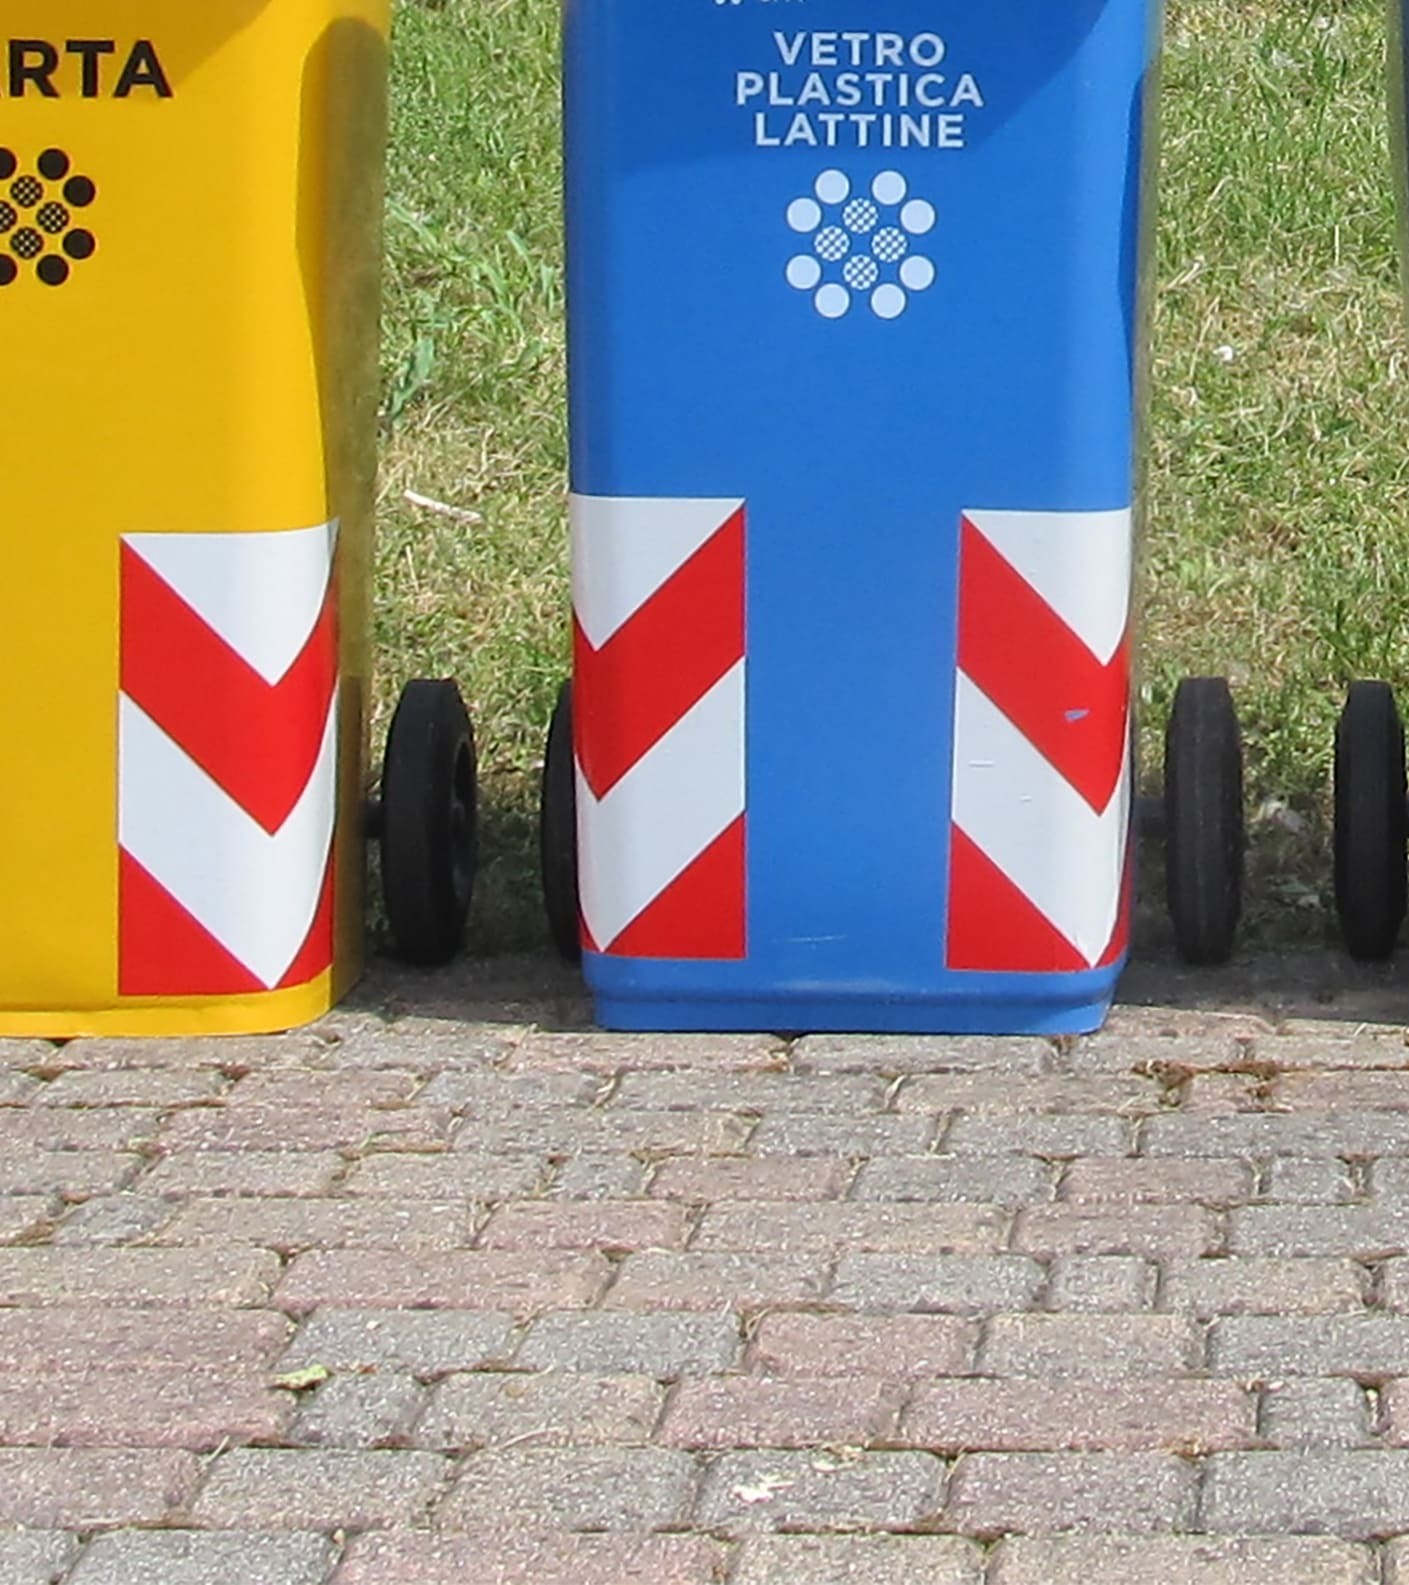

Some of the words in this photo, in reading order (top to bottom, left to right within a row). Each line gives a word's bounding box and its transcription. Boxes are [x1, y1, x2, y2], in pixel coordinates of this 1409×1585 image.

[773, 31, 945, 67] VETRO
[736, 72, 984, 107] PLASTICA
[755, 112, 965, 148] LATTINE
